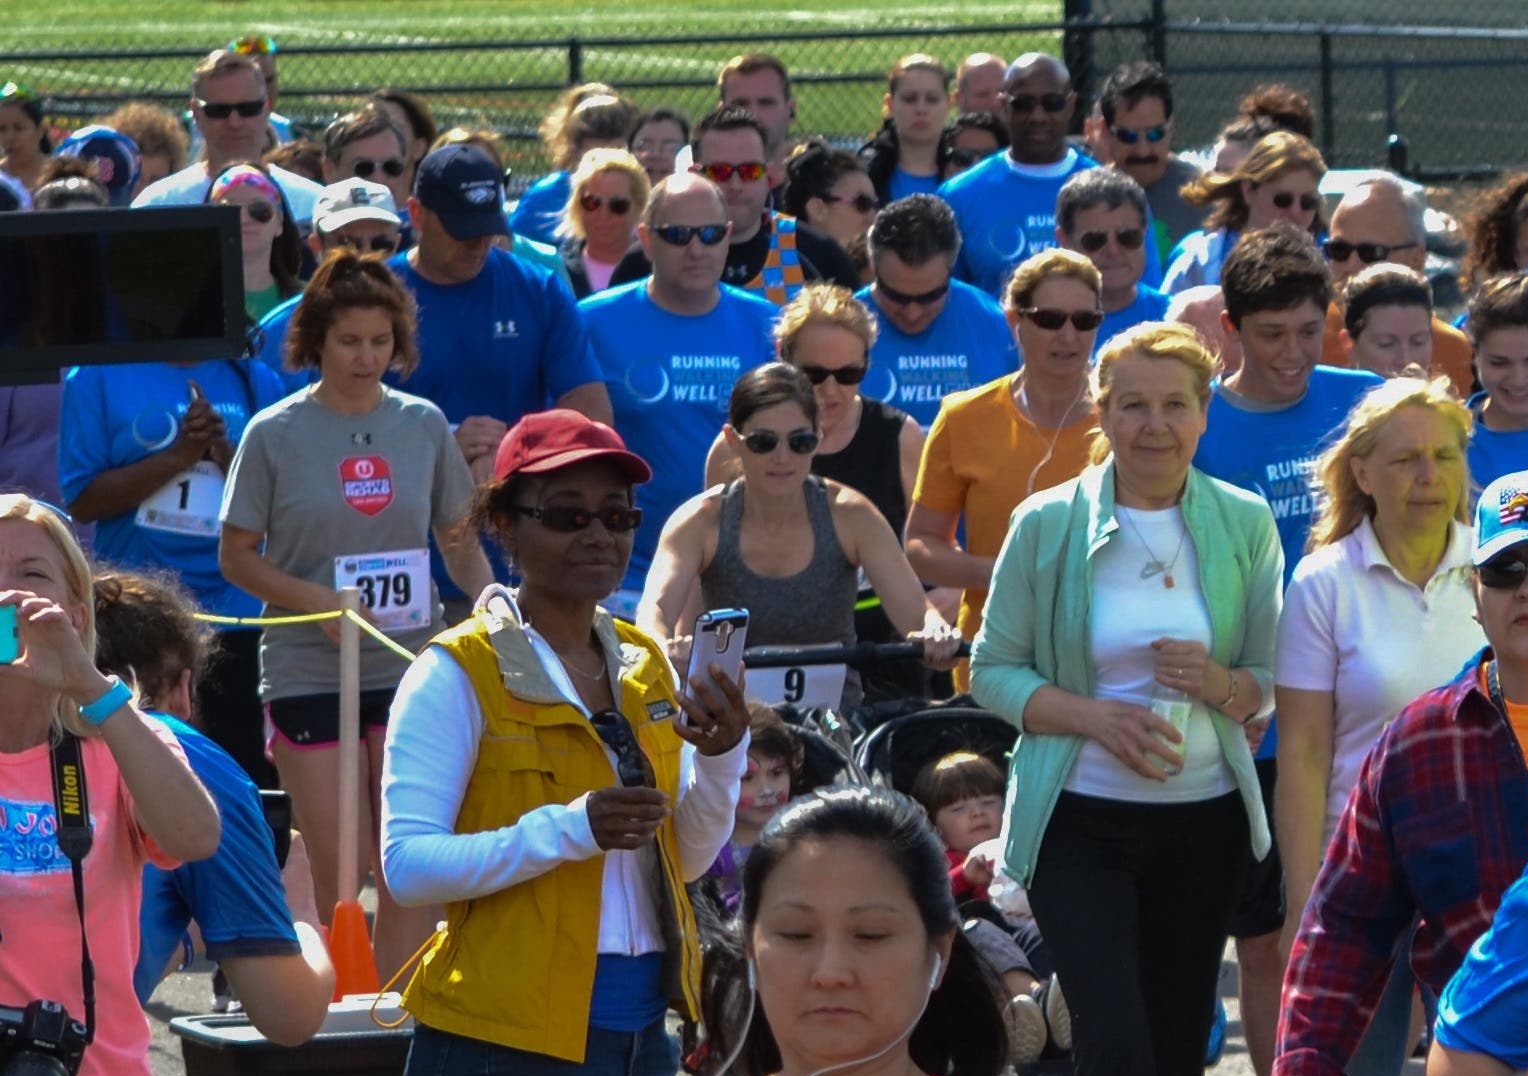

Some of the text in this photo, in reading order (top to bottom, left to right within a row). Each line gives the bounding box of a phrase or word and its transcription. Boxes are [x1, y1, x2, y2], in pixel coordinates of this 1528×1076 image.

[671, 355, 741, 369] RUNNING
[898, 354, 968, 369] RUNNING
[673, 384, 718, 402] WELL
[178, 480, 191, 510] 1
[356, 572, 411, 608] 379
[783, 668, 806, 703] 9
[62, 765, 80, 815] Nikon
